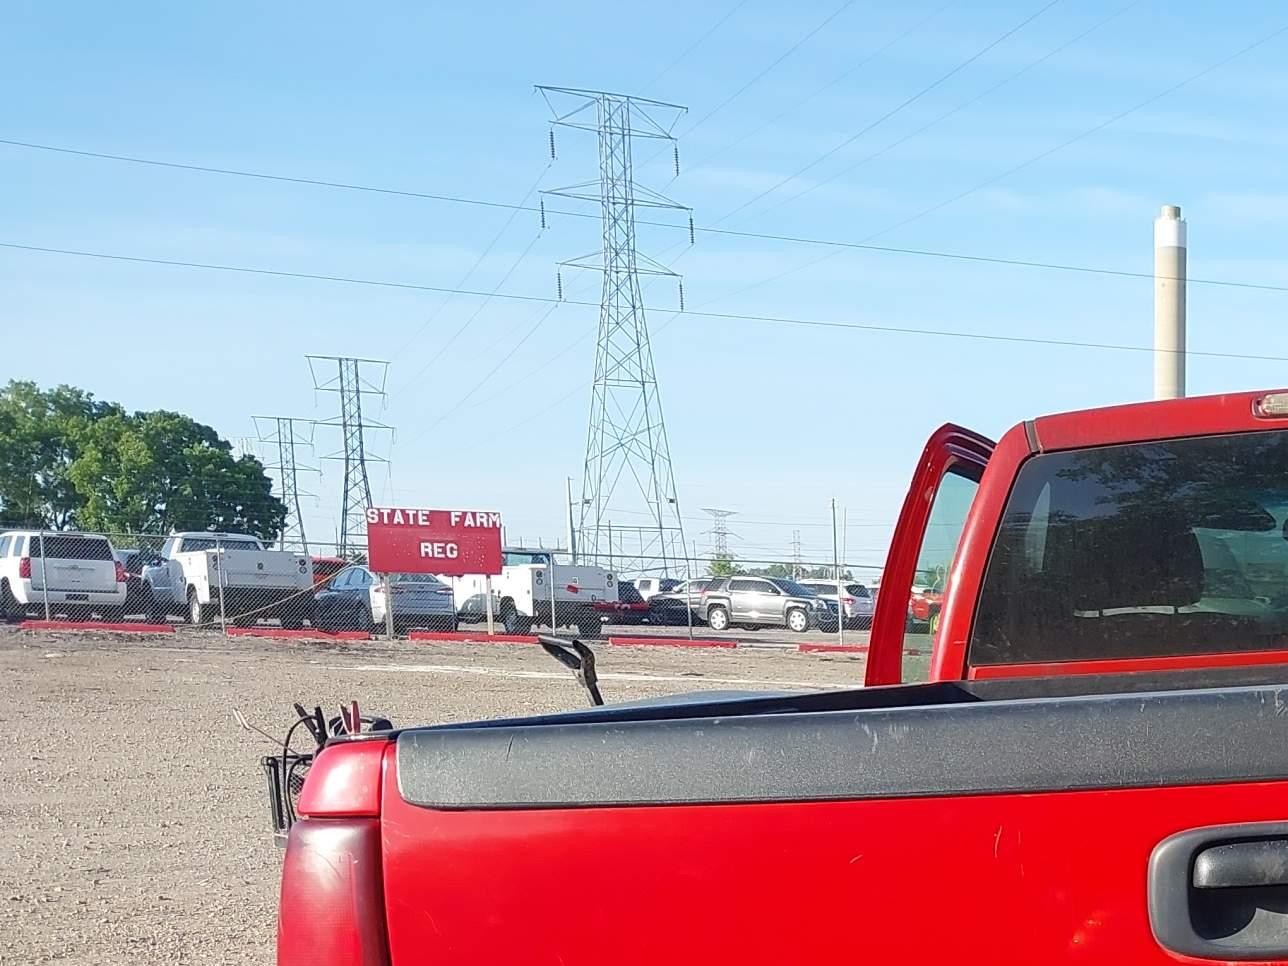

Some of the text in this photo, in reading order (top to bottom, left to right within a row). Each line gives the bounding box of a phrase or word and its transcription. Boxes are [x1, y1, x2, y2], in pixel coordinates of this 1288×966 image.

[366, 508, 502, 528] STATE FARM
[421, 542, 457, 559] REG
